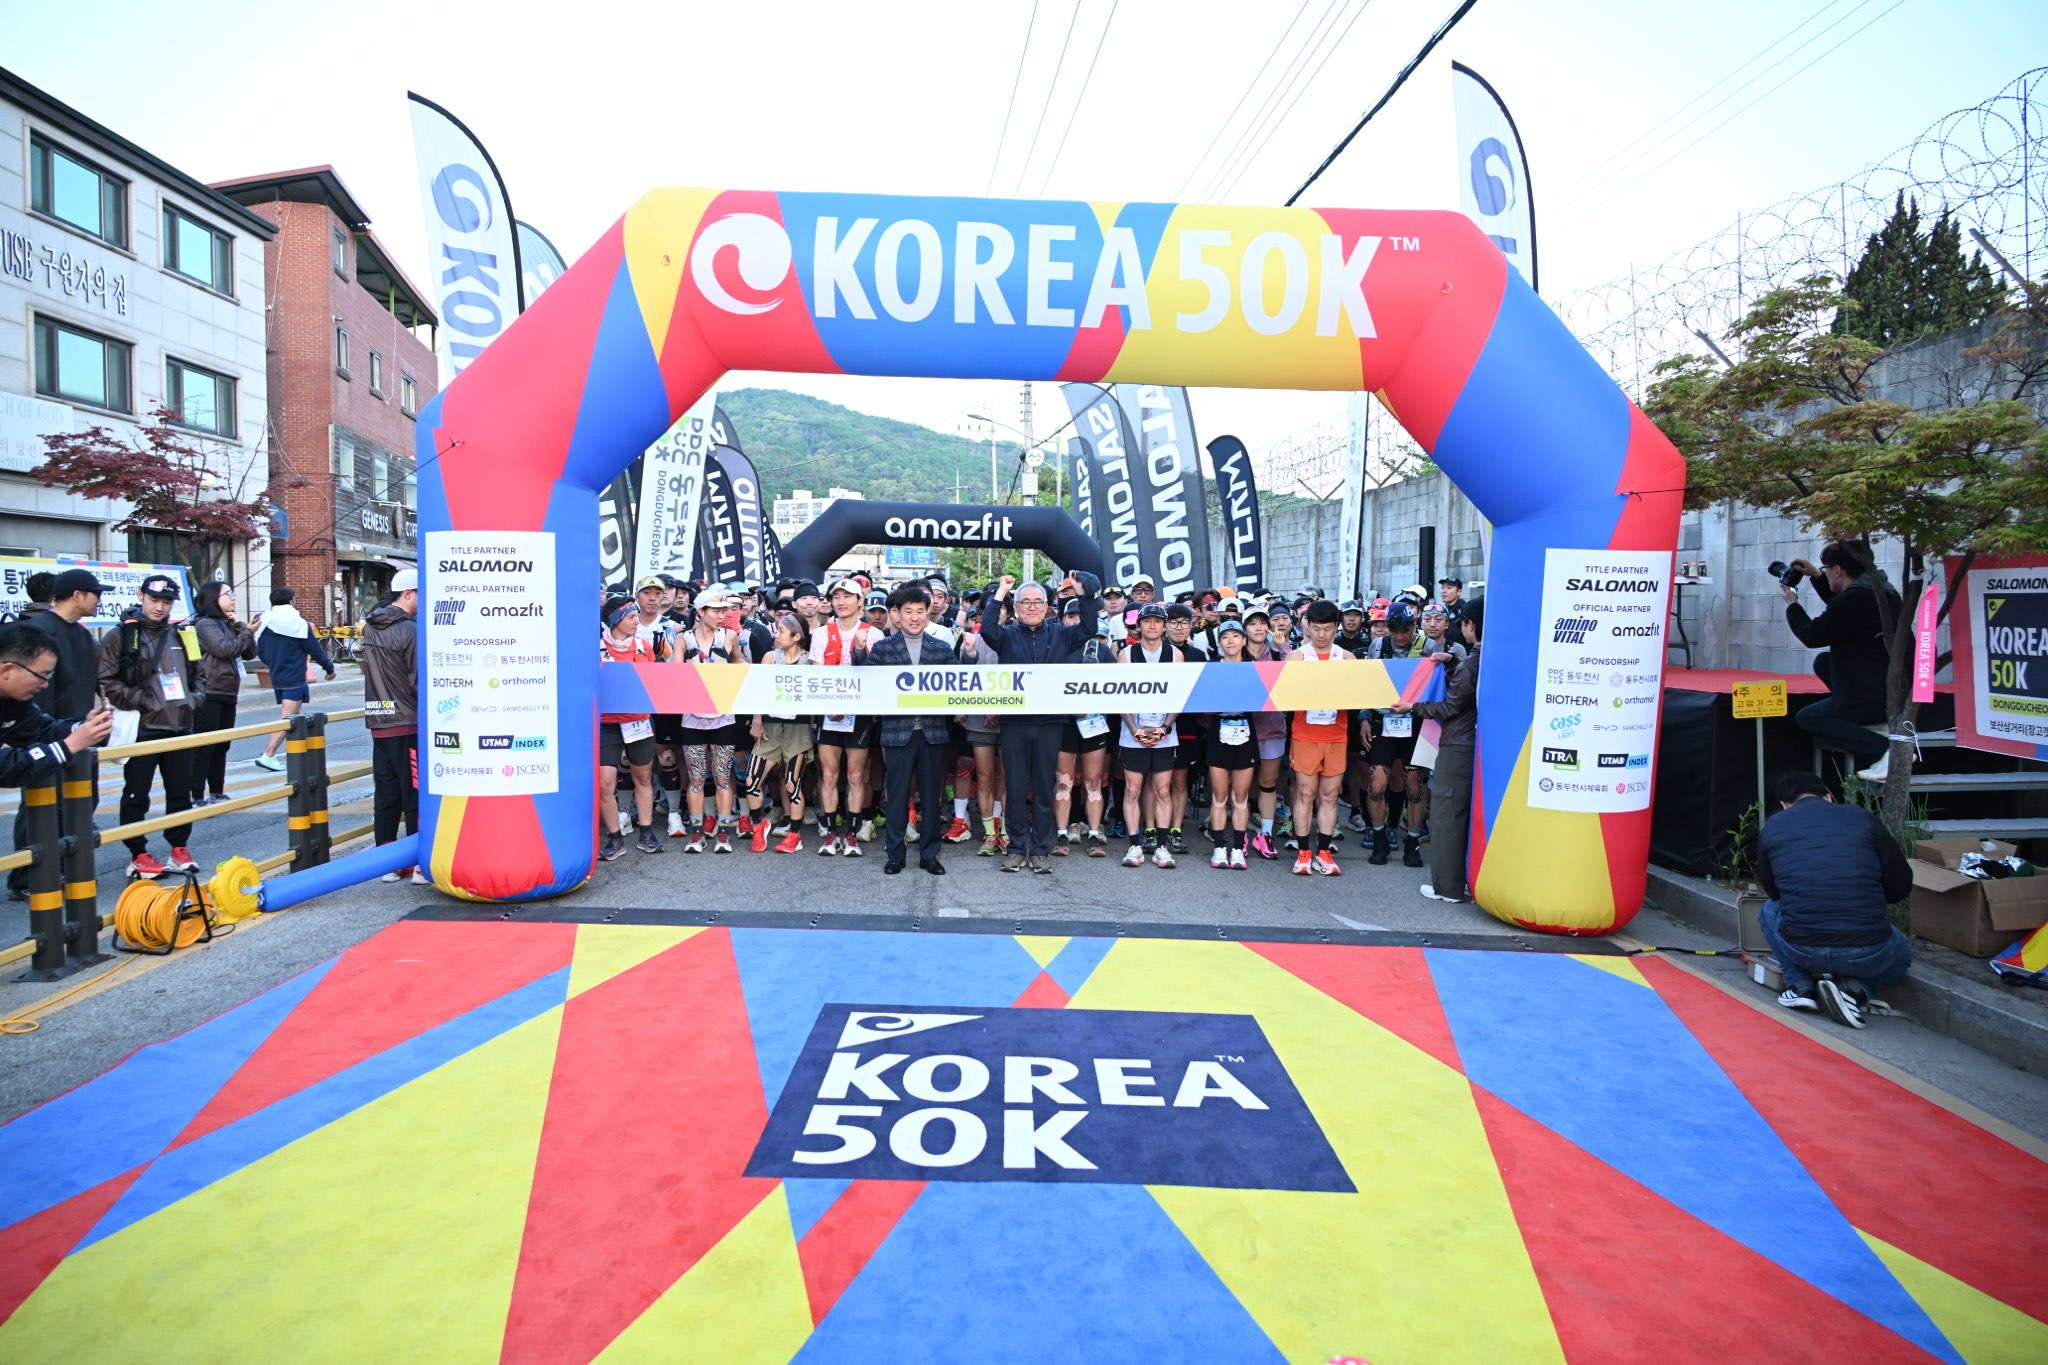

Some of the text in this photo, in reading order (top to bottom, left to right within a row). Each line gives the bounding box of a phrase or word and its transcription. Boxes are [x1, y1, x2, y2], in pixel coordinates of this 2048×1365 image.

[0, 229, 33, 282] USE
[40, 245, 127, 315] 구원자의 집
[813, 215, 1152, 330] KOREA
[1176, 229, 1383, 339] 50K
[362, 509, 389, 534] GENESIS
[650, 470, 667, 571] DONGDUCHEON-SI
[663, 473, 696, 571] 동두천시
[885, 512, 1013, 541] amazfit
[439, 560, 533, 572] SALOMON
[1585, 565, 1609, 573] TITLE
[1565, 578, 1659, 592] SALOMON
[434, 597, 466, 612] amino
[480, 603, 543, 616] amazfit
[1573, 604, 1614, 612] OFFICIAL
[433, 613, 456, 625] VITAL
[1554, 615, 1598, 631] amino
[1612, 622, 1659, 636] amazfit
[1553, 631, 1585, 644] VITAL
[1989, 627, 2048, 656] KOREA
[1919, 631, 1931, 660] KOREA
[1579, 657, 1640, 666] SPONSORSHIP
[1918, 661, 1930, 680] 50K
[1991, 660, 2028, 689] 50K
[433, 678, 473, 688] BIOTHERM
[502, 676, 546, 685] orthomol
[807, 677, 861, 693] 동두천시
[918, 671, 983, 691] KOREA
[986, 671, 1025, 691] 50K
[1063, 681, 1168, 694] SALOMON
[948, 697, 1023, 705] DONGDUCHEON
[1545, 693, 1598, 706] BIOTHERM
[1624, 694, 1654, 704] orthomol
[482, 738, 544, 748] UTMB INDEX
[1601, 757, 1648, 766] UTMB INDEX
[817, 1051, 1270, 1110] KOREA
[792, 1104, 1099, 1171] 50K
